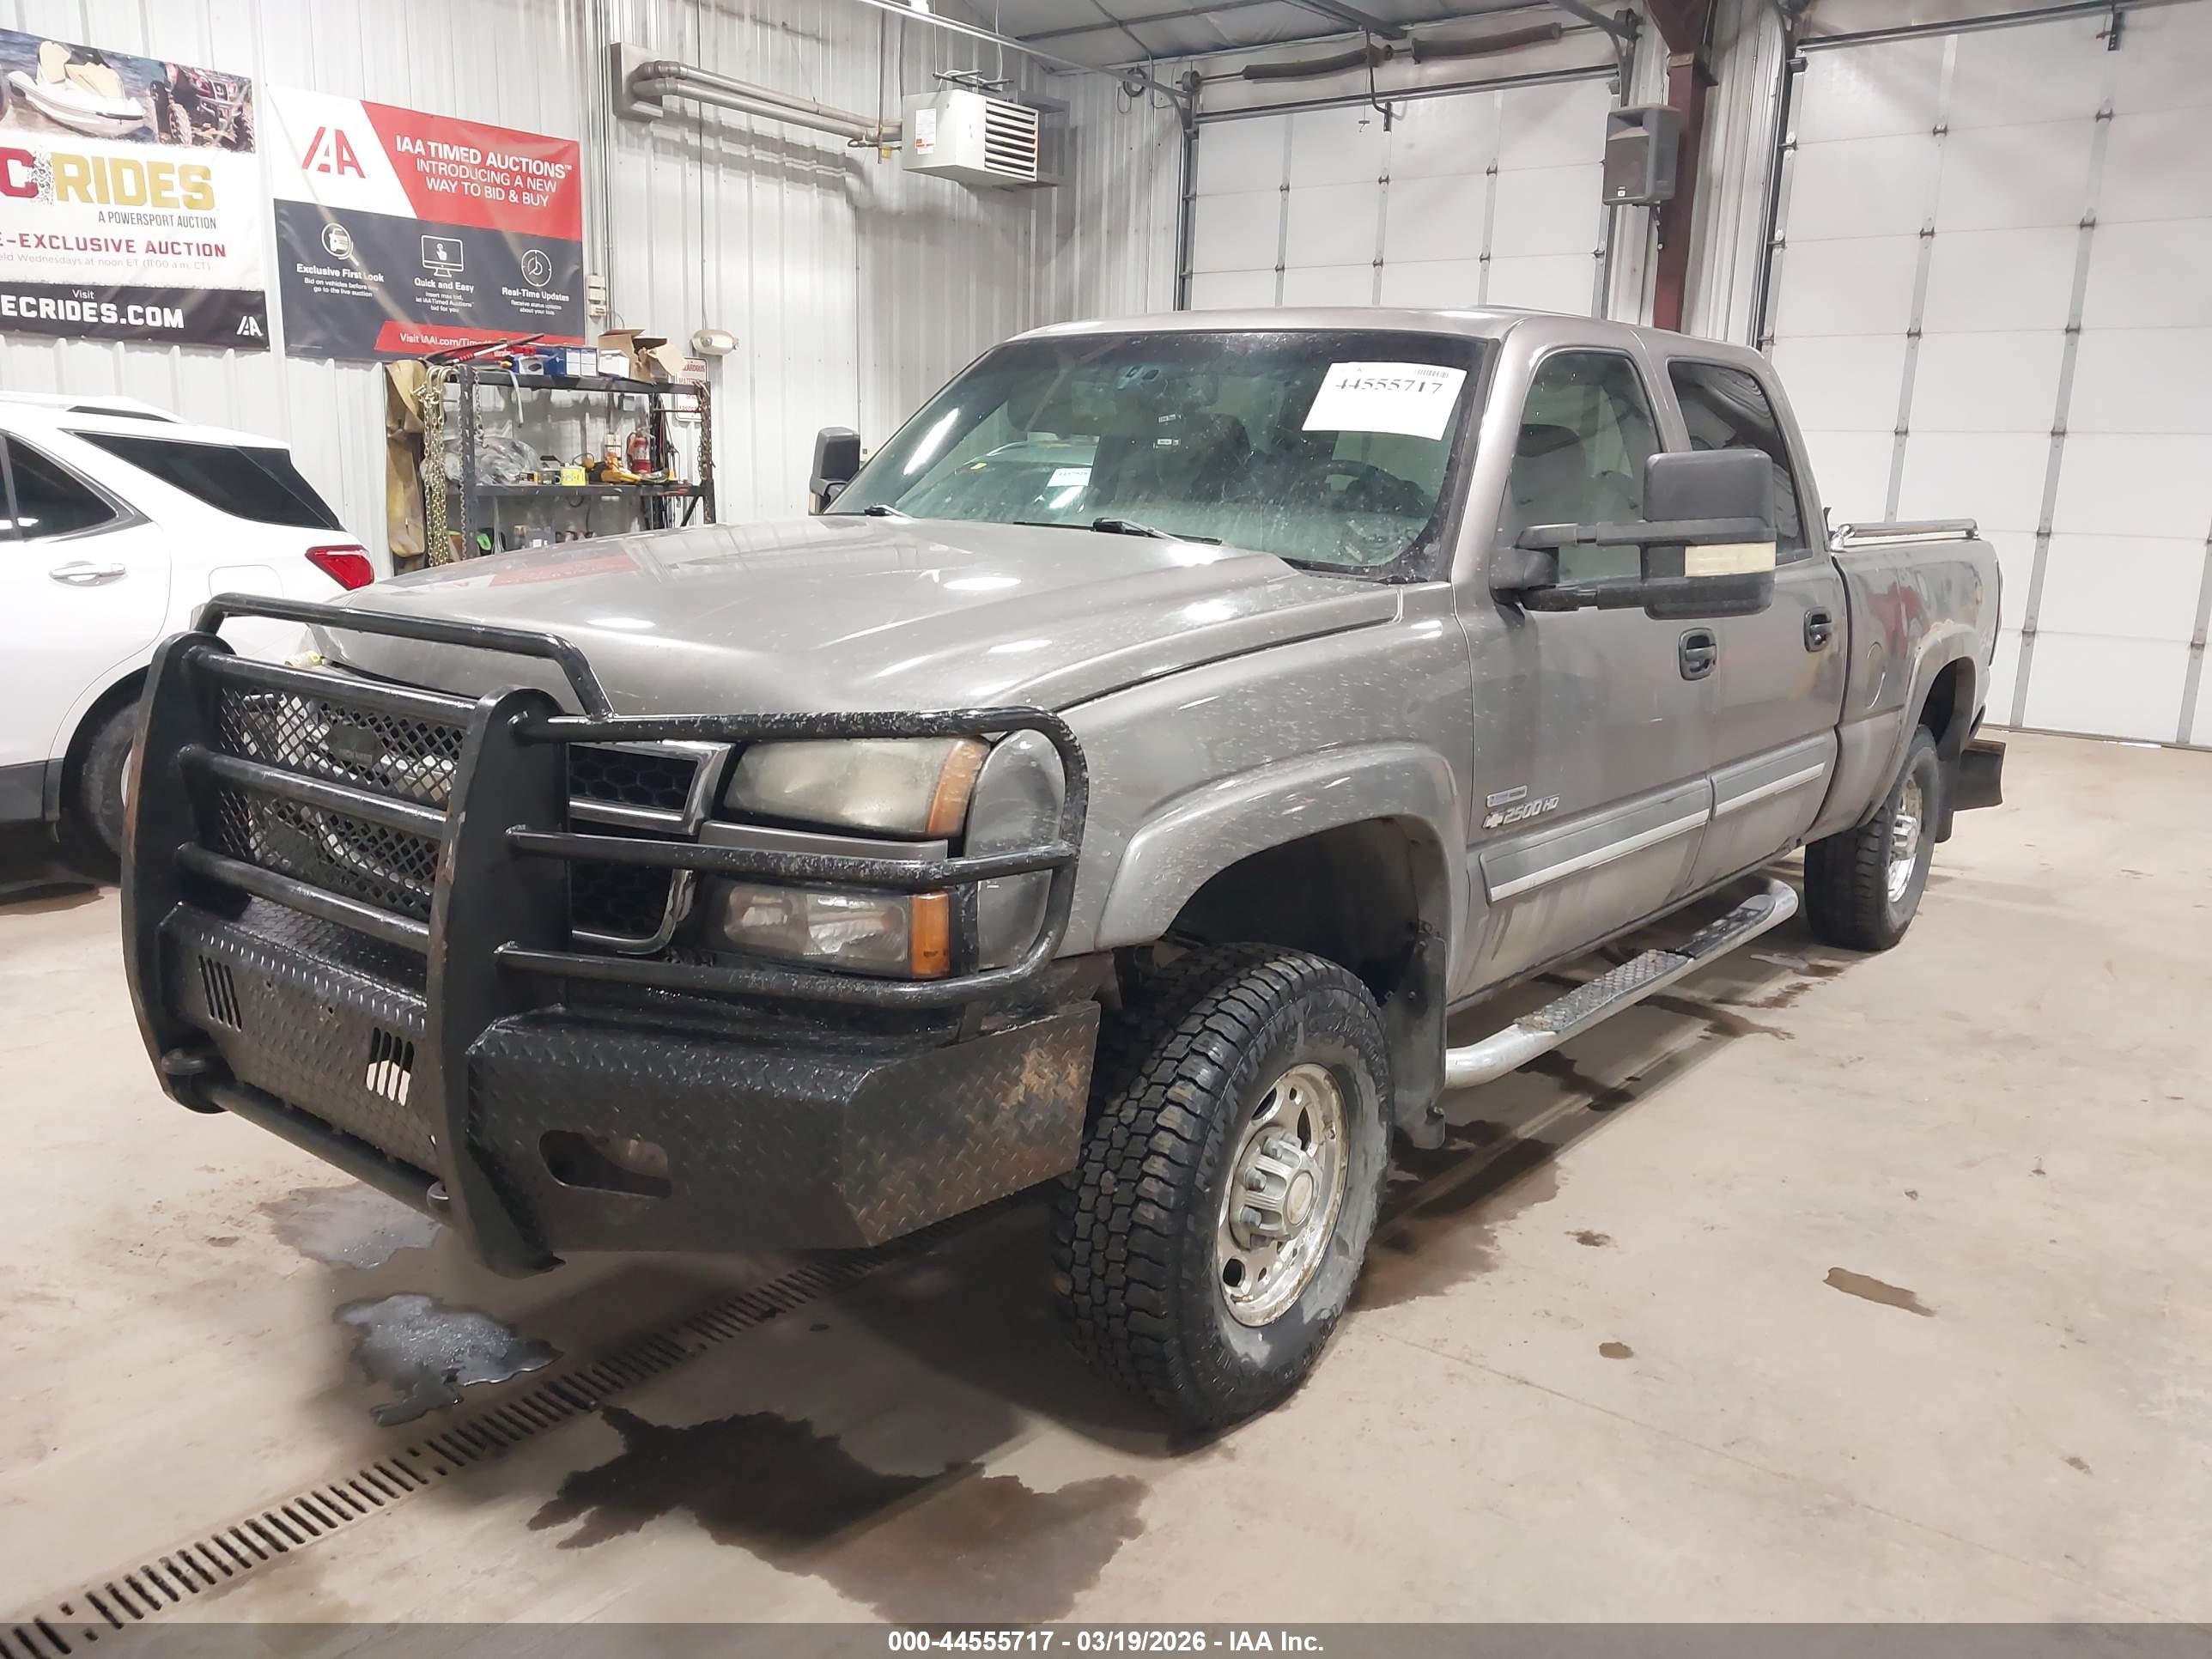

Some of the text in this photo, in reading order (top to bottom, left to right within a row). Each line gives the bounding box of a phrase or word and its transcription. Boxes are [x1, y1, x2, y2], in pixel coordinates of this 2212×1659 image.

[396, 135, 425, 155] IAA
[427, 142, 481, 165] TIMED
[52, 152, 216, 211] RIDES
[416, 158, 557, 193] INTRODUCING A NEW
[426, 176, 550, 207] WAY TO BID & BUY
[98, 210, 217, 230] A POWERSPORT AUCTION
[145, 240, 227, 258] AUCTION
[17, 253, 82, 266] Wednesdays
[296, 263, 341, 277] Exclusive
[342, 268, 362, 279] First
[414, 276, 475, 294] Quick and Easy
[501, 286, 569, 302] Real-Time Updates
[72, 289, 95, 300] Visit
[0, 295, 185, 329] ECRIDES.COM
[399, 332, 420, 343] Visit
[1335, 378, 1443, 395] 44555717
[1503, 799, 1543, 825] 2500
[1542, 795, 1560, 811] HD
